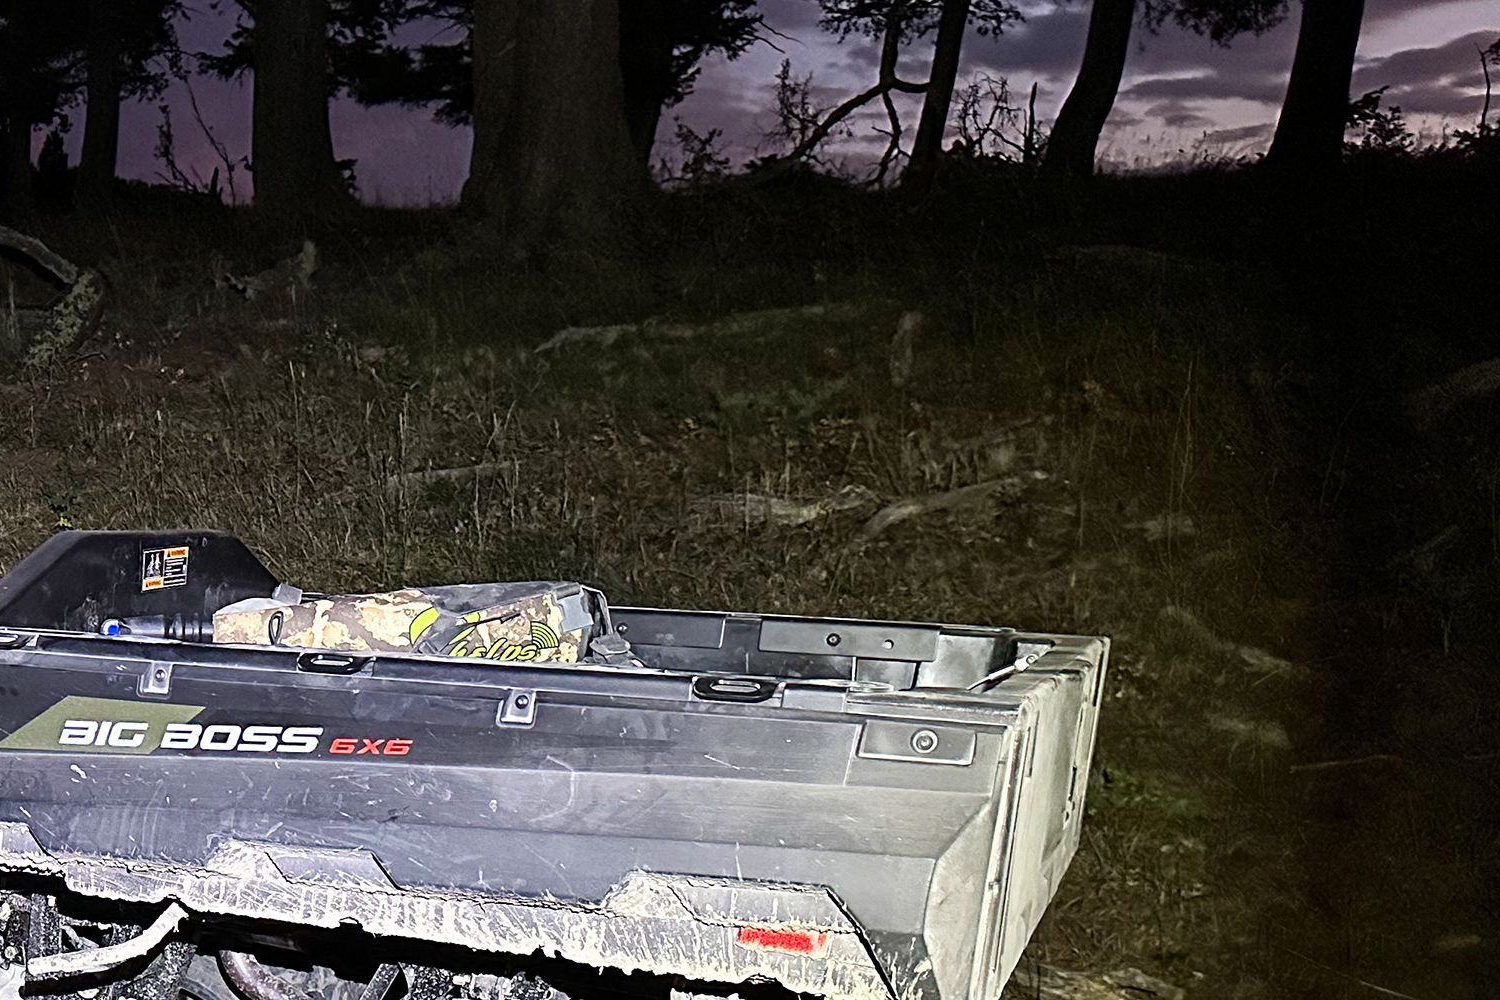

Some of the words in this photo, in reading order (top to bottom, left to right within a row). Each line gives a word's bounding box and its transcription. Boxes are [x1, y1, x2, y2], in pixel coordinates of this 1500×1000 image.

[58, 719, 150, 748] BIG
[160, 723, 324, 753] BOSS
[329, 738, 414, 755] 6X6
